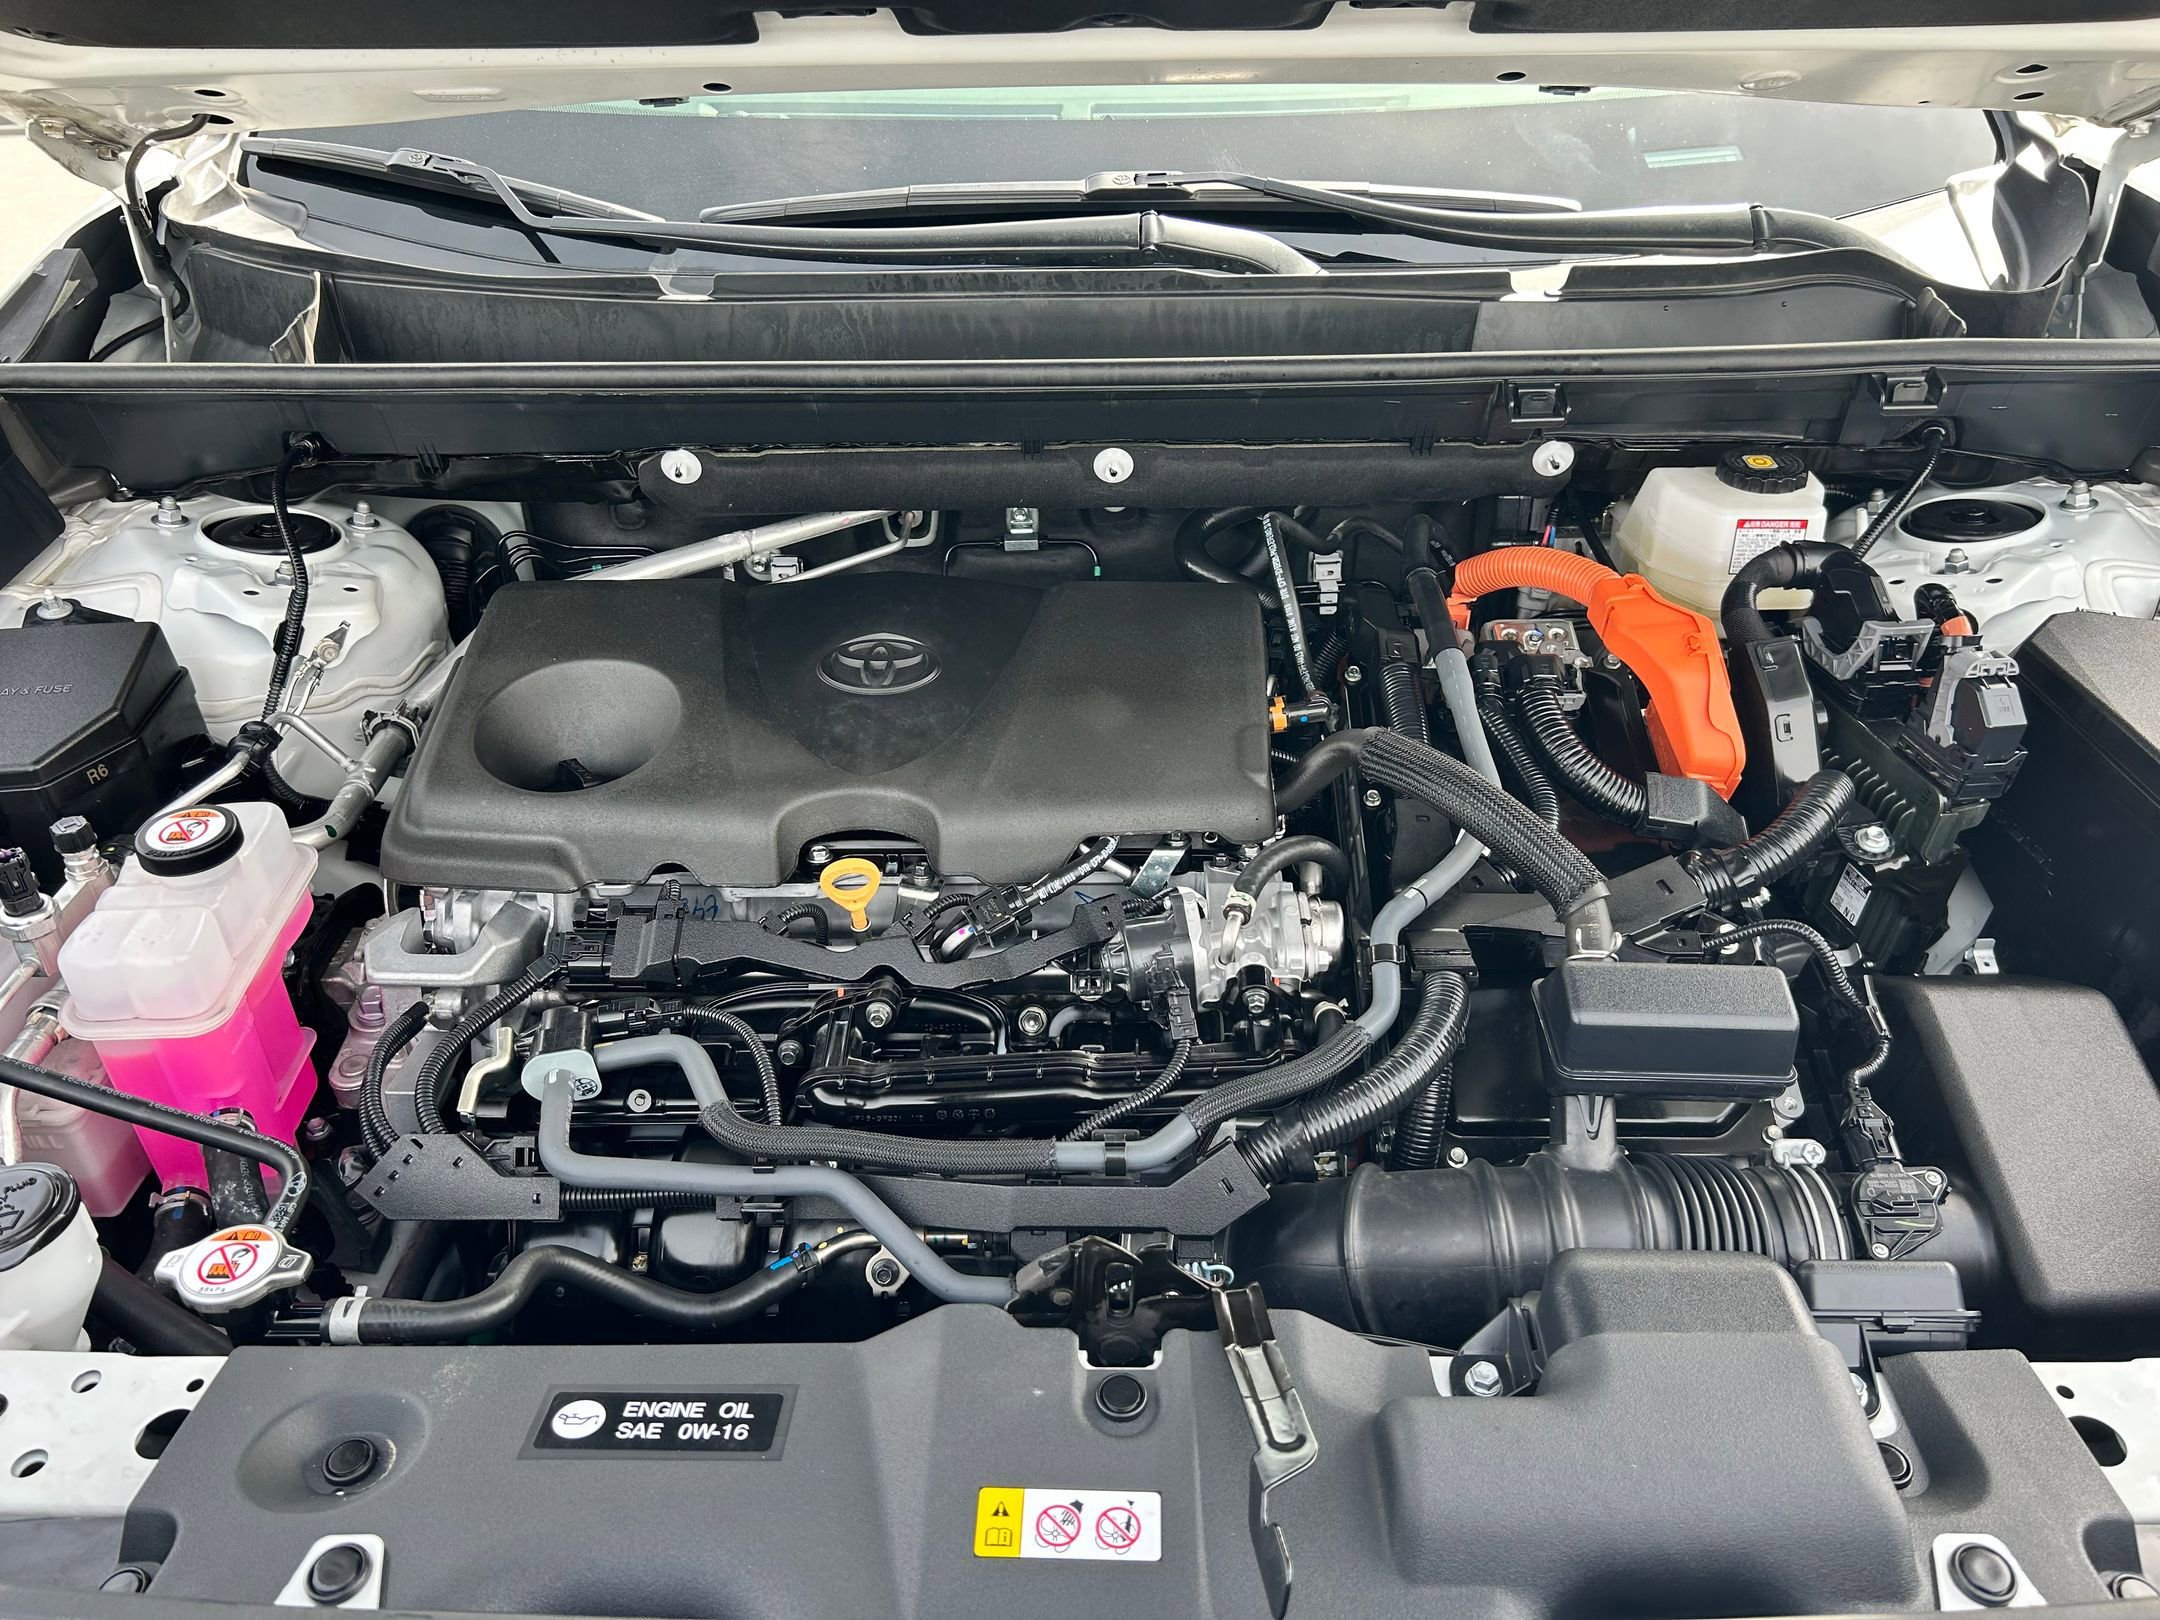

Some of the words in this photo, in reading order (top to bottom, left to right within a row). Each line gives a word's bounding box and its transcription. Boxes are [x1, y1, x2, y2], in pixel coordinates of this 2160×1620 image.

[34, 684, 73, 694] FUSE
[86, 763, 109, 785] R6
[622, 1400, 707, 1419] ENGINE
[718, 1401, 756, 1420] OIL
[614, 1422, 665, 1440] SAE
[677, 1423, 750, 1441] 0W-16
